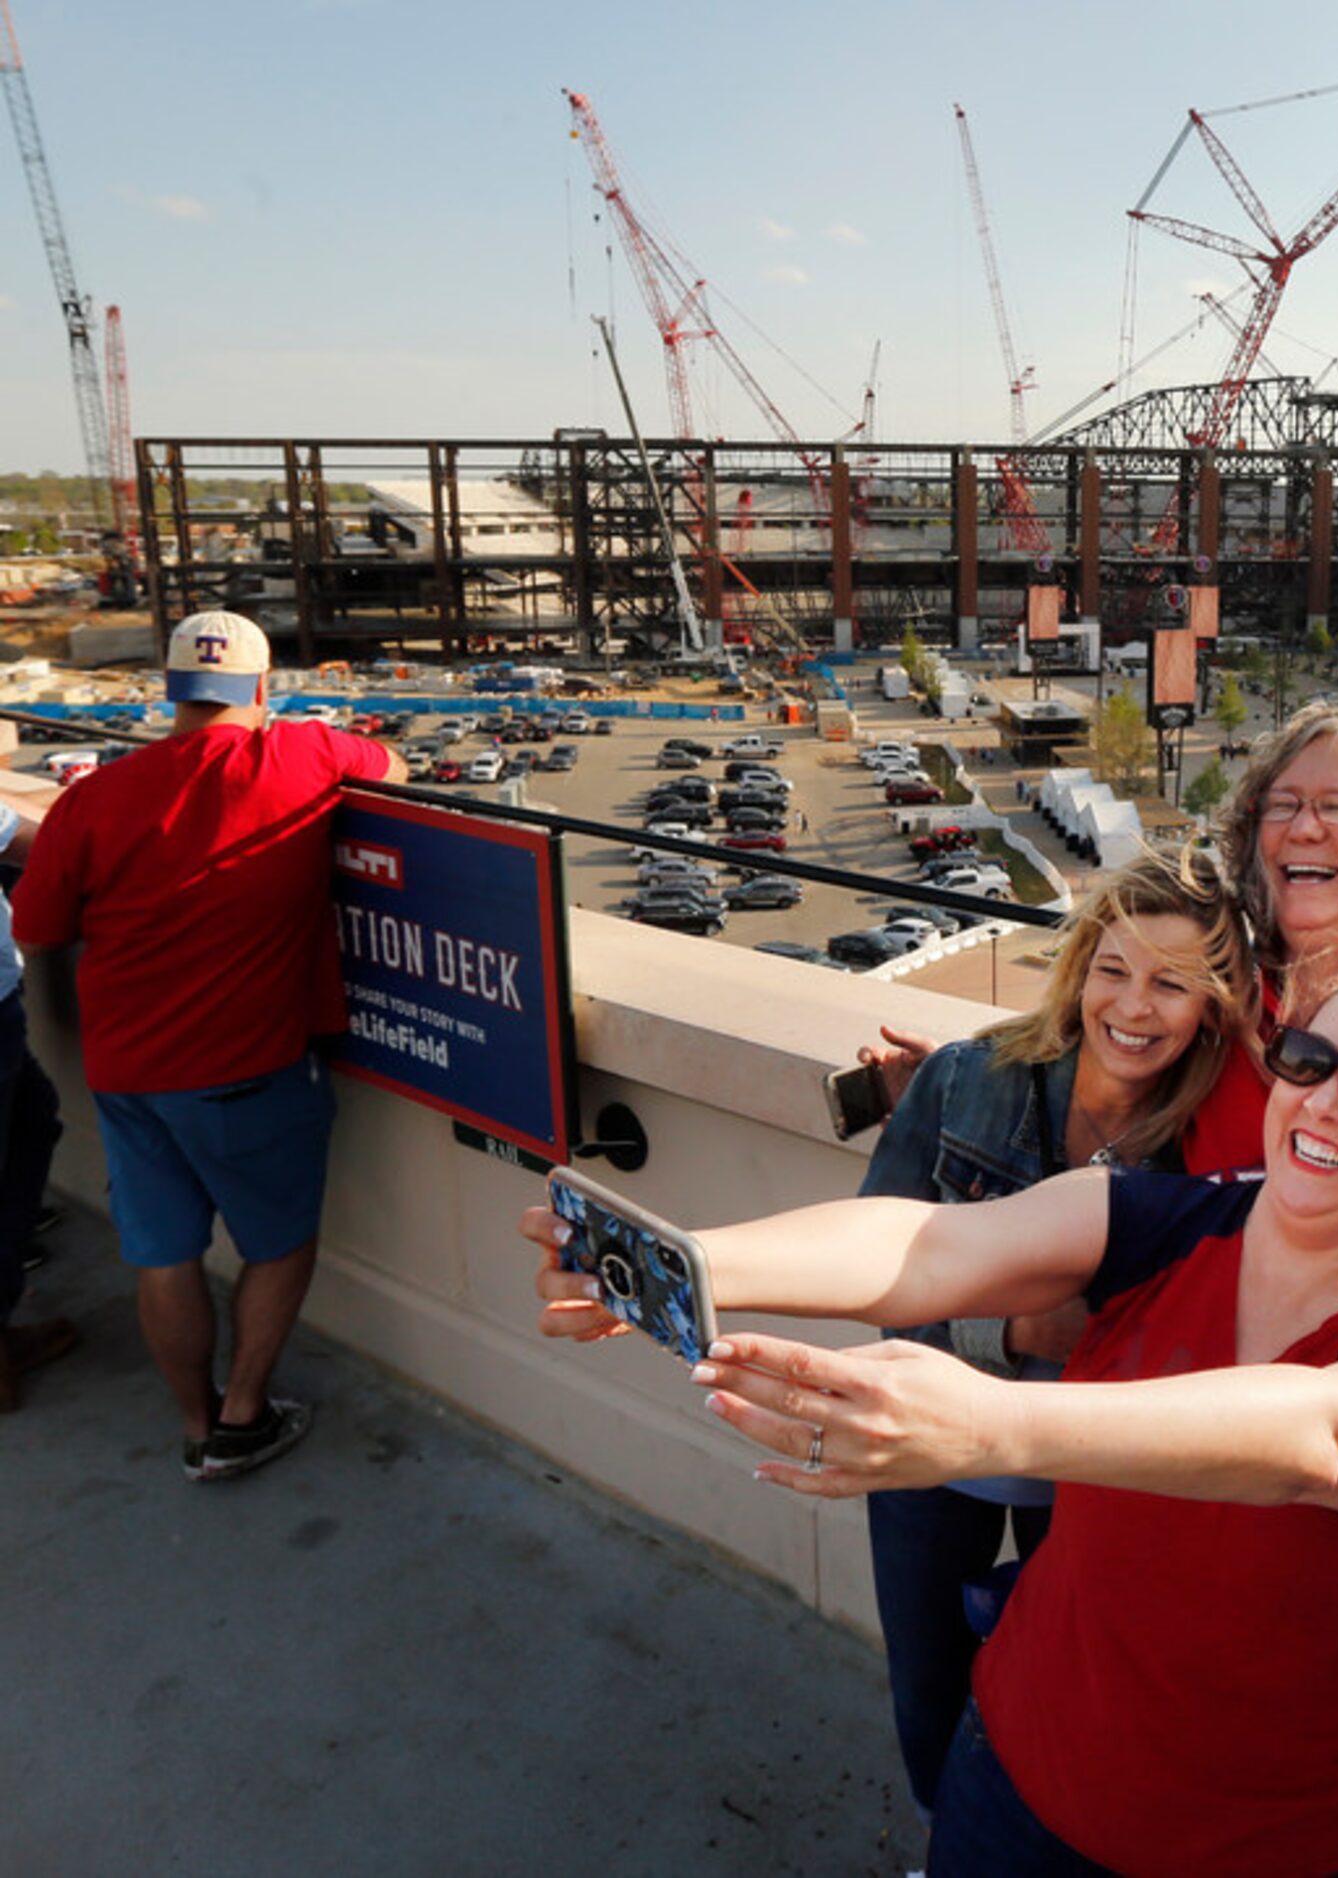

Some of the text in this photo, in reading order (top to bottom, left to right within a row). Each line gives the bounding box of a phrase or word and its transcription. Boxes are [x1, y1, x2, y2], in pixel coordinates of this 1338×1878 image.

[195, 636, 227, 664] T
[434, 931, 522, 1011] DECK
[354, 984, 388, 1009] SHARE
[389, 996, 418, 1019] YOUR
[419, 1006, 454, 1032] STORY
[456, 1019, 486, 1045] WITH
